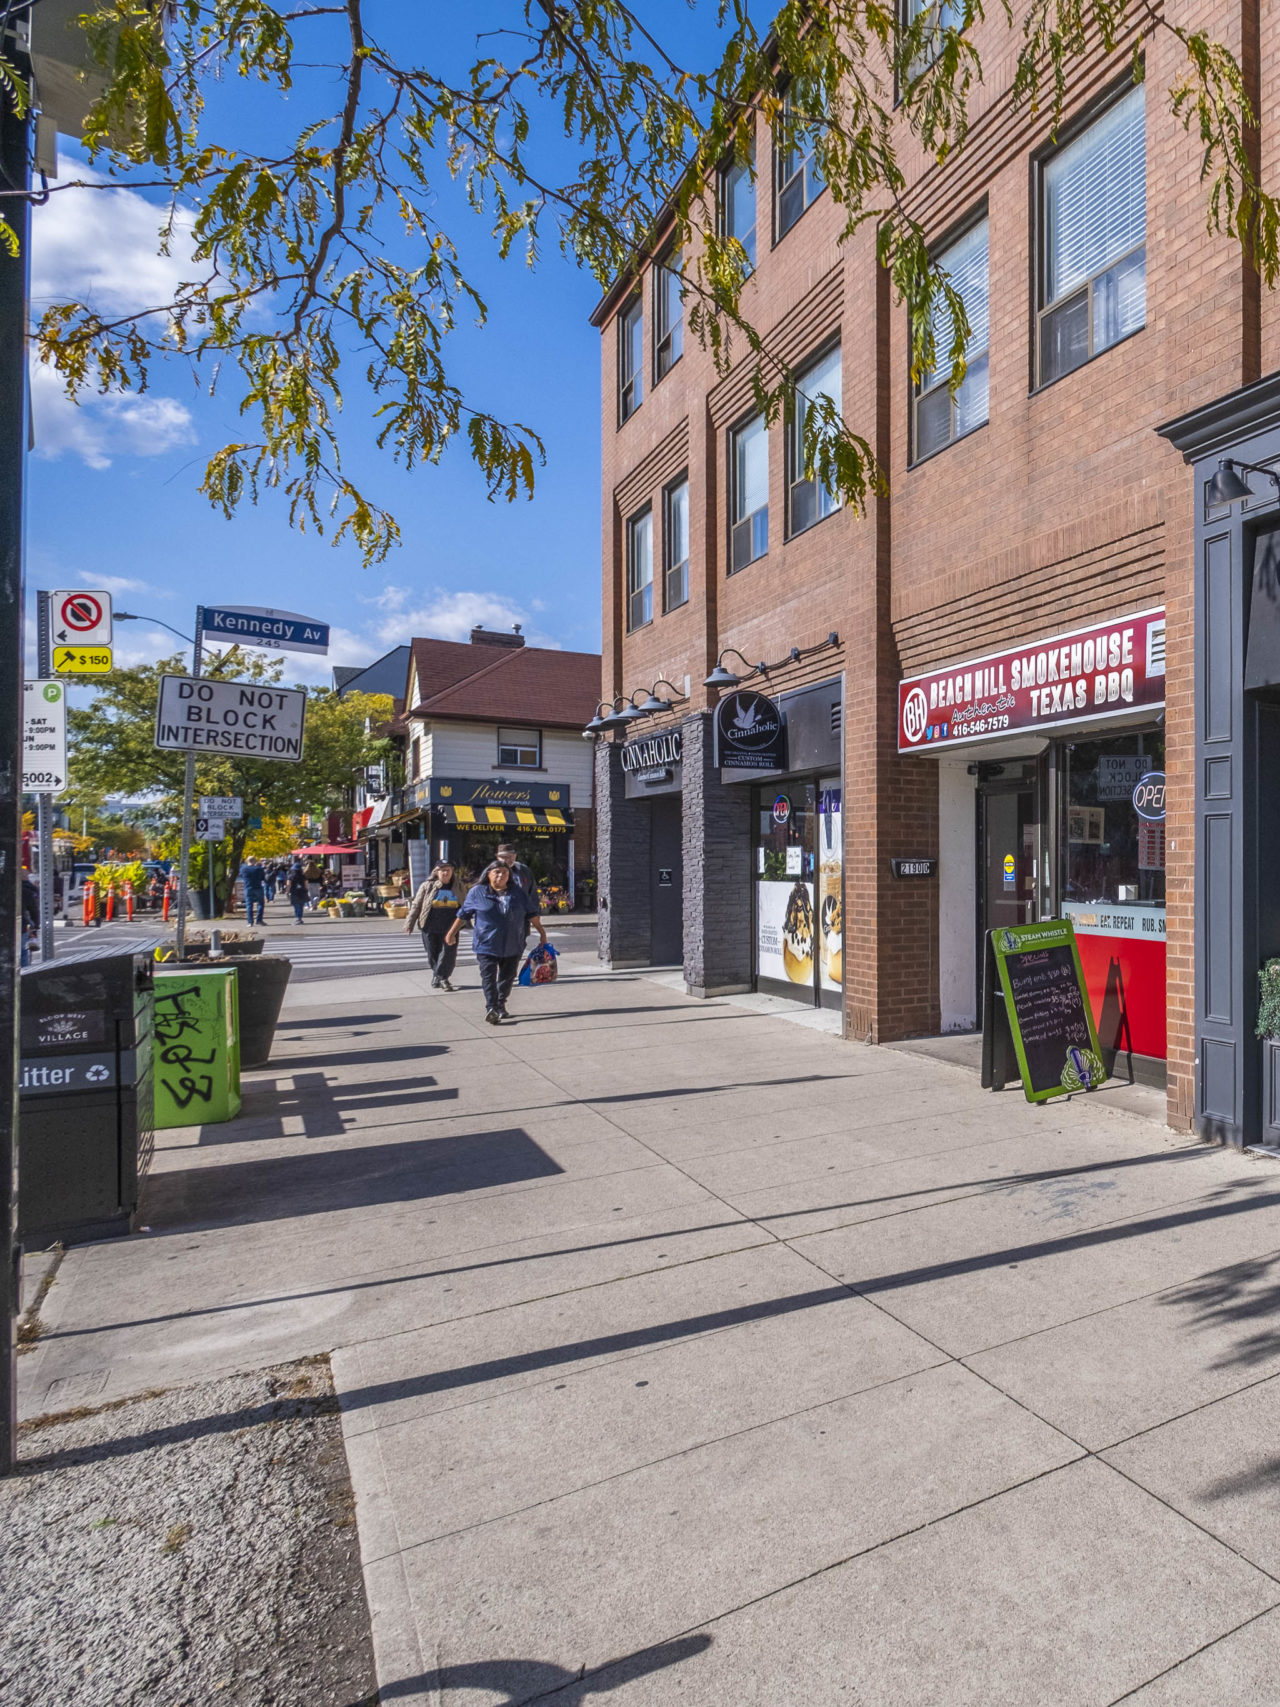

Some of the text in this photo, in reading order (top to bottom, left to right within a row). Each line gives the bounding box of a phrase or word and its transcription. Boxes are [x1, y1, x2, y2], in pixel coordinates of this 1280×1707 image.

[213, 612, 321, 640] Kennedy Av
[256, 638, 281, 648] 245
[89, 655, 109, 665] 150
[930, 628, 1135, 710] BEACH HILL SMOKEHOUSE
[179, 682, 288, 711] DO NOT
[1030, 668, 1135, 717] TEXAS BBQ
[187, 706, 277, 731] BLOCK
[951, 693, 1016, 724] Authentic
[727, 720, 778, 739] Cinnaholic
[952, 714, 1010, 737] 416-546-7579
[161, 724, 299, 754] INTERSECTION
[621, 733, 682, 772] CINNAHOLIC
[472, 824, 505, 832] DELIVER
[1021, 932, 1041, 942] STEAM
[1041, 928, 1068, 939] WHISTLE
[1112, 916, 1135, 931] REPEAT
[1142, 917, 1156, 932] RUB.
[38, 1031, 89, 1042] VILLAGE
[18, 1066, 76, 1088] itter
